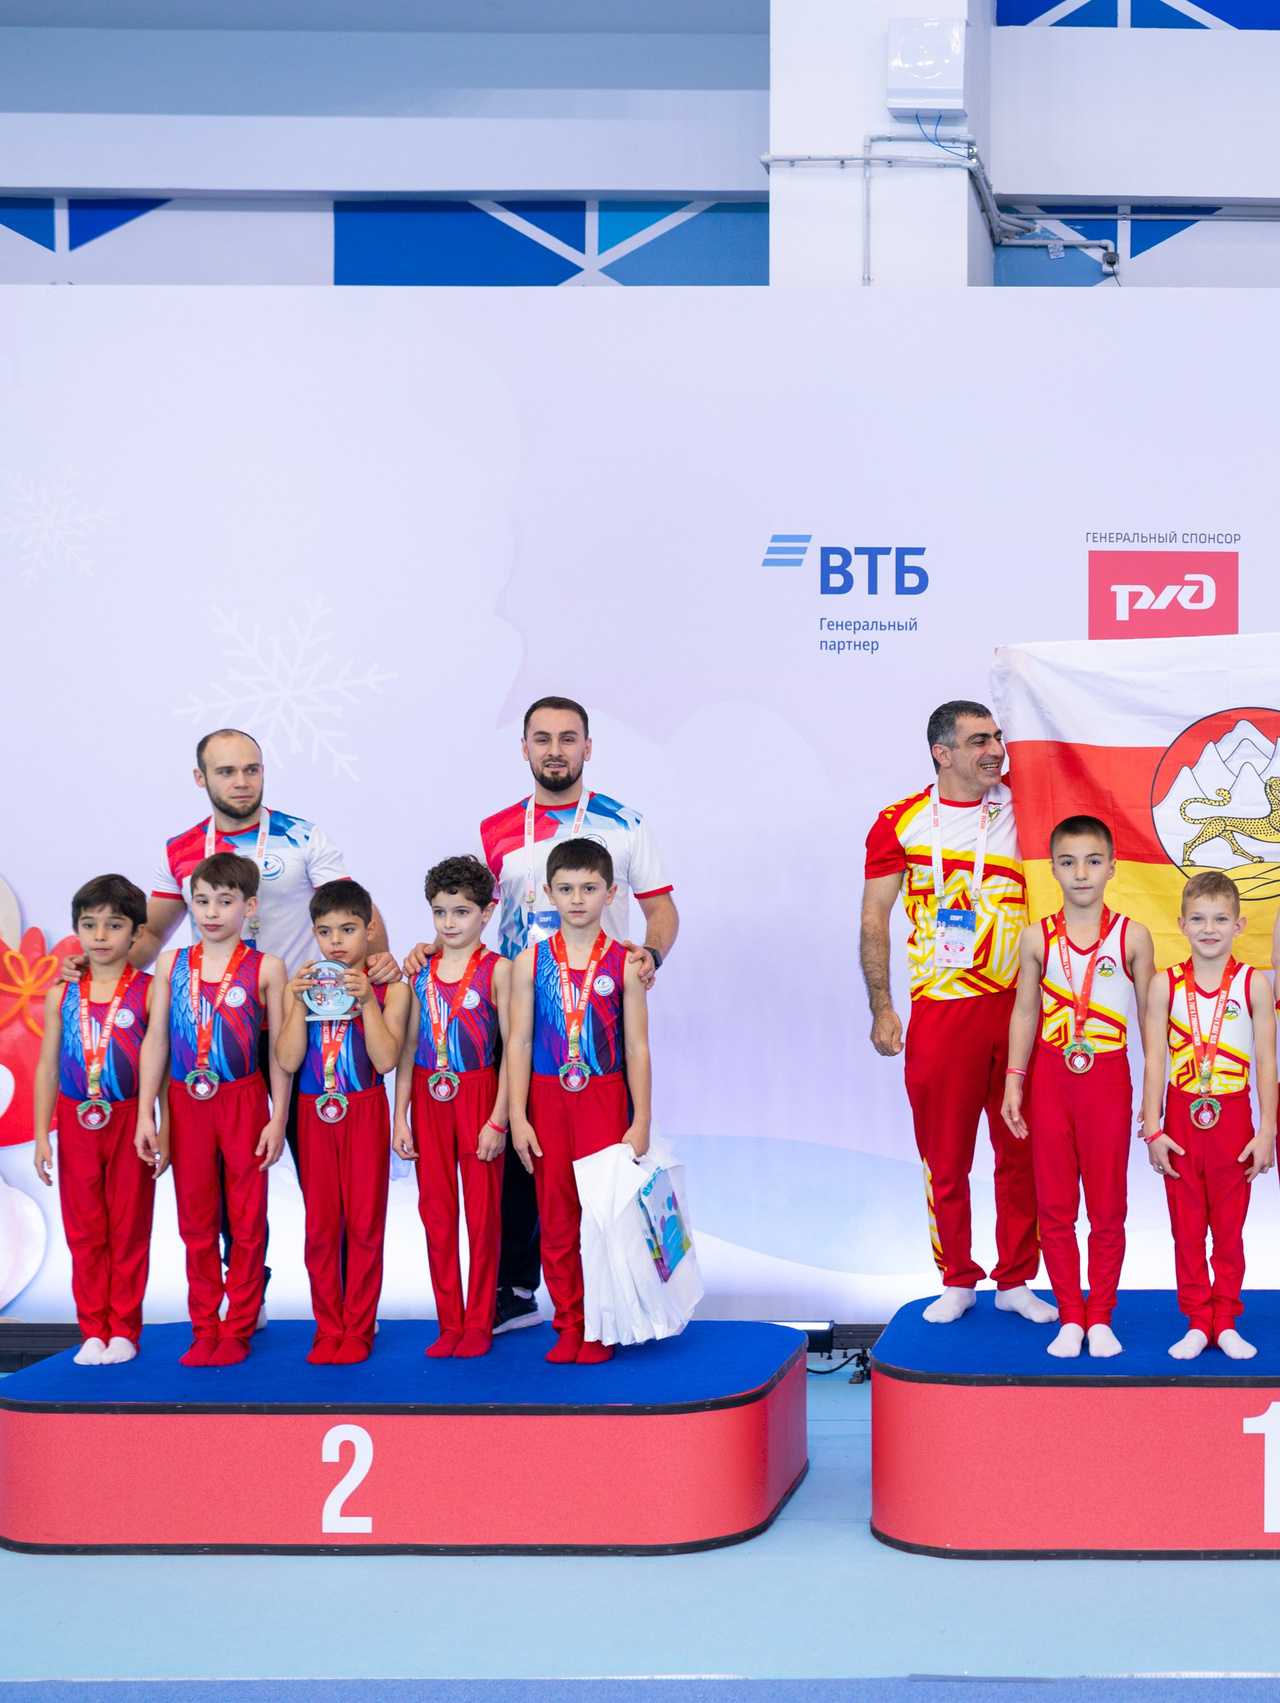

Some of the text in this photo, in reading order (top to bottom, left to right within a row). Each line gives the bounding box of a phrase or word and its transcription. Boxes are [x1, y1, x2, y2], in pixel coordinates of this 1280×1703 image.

[1085, 531, 1242, 544] ГЕНЕРАЛЬНЫЙ СПОНСОР
[819, 546, 930, 596] ВТБ
[819, 617, 918, 632] Генеральный
[819, 638, 880, 654] партнер
[321, 1423, 374, 1534] 2
